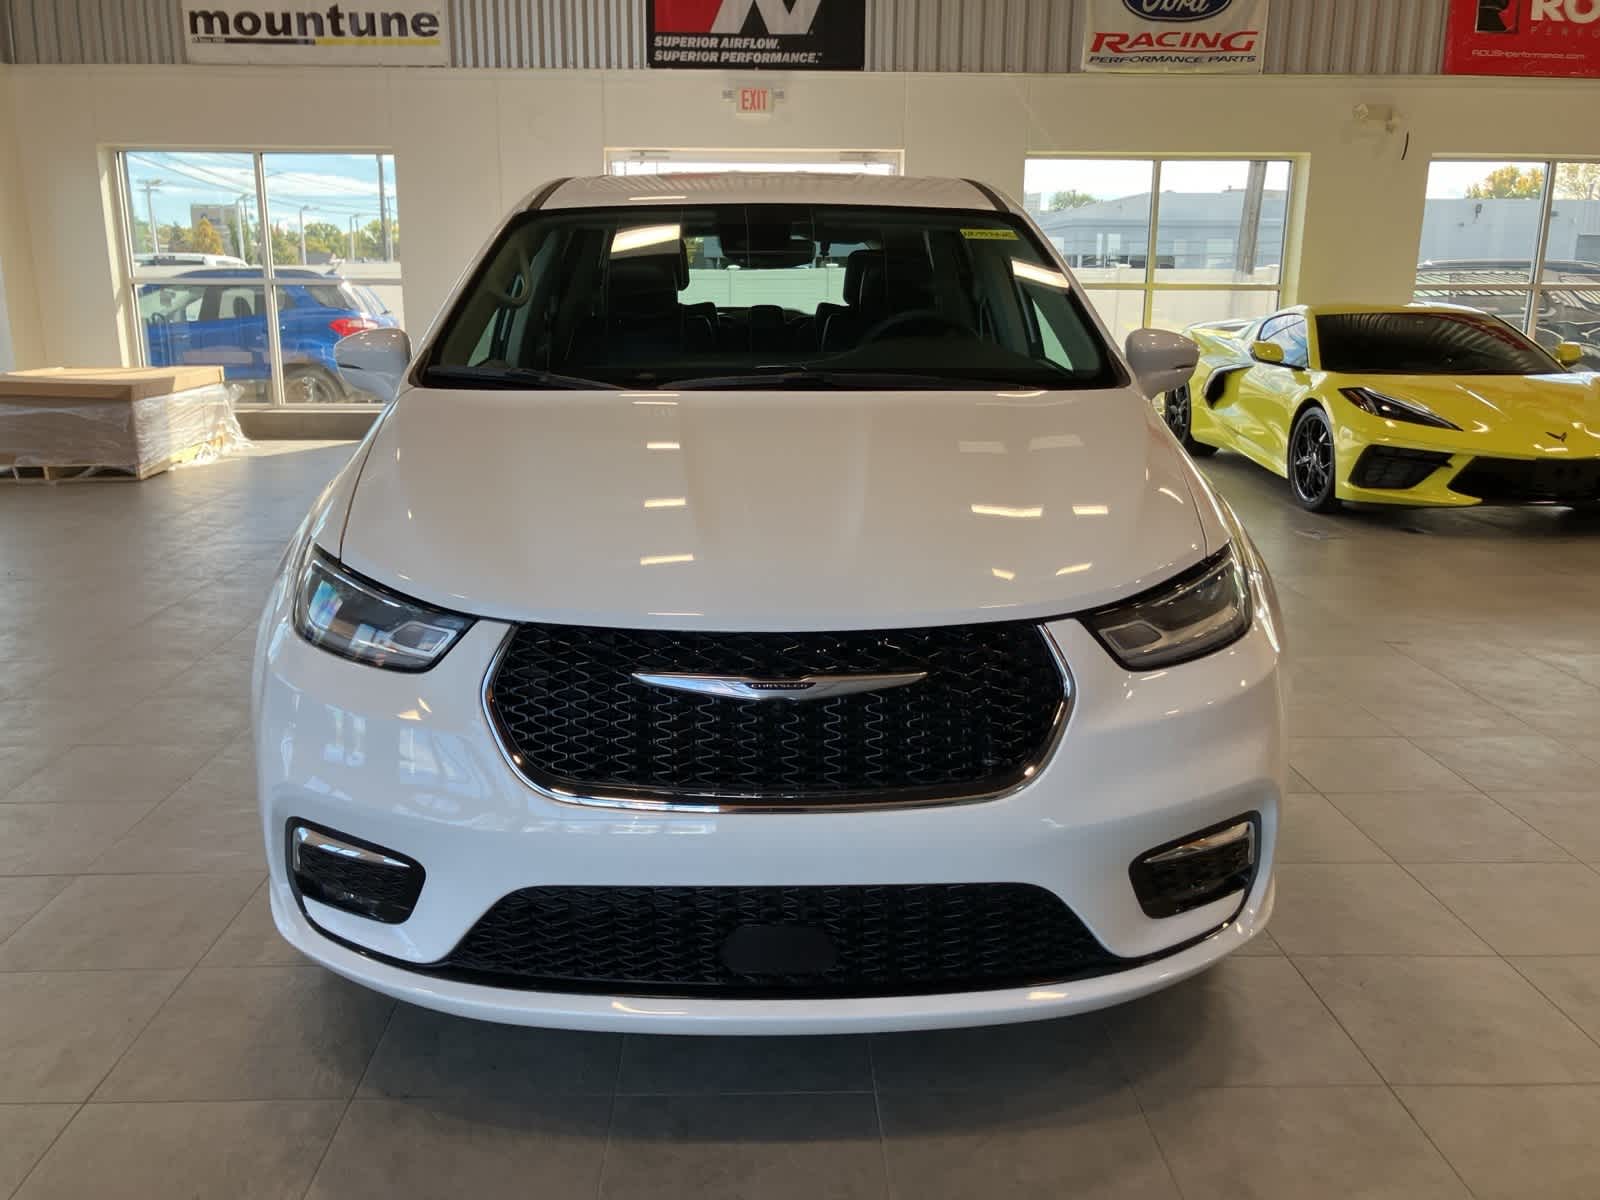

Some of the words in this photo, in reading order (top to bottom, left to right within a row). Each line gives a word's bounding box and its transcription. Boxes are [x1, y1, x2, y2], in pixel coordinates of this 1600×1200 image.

[189, 3, 440, 37] mountune
[654, 36, 719, 49] SUPERIOR
[720, 37, 781, 50] AIRFLOW.
[1090, 31, 1259, 53] RACING
[654, 50, 719, 63] SUPERIOR
[1089, 55, 1201, 64] PERFORMANCE
[1207, 55, 1257, 63] PARTS
[741, 89, 768, 111] EXIT
